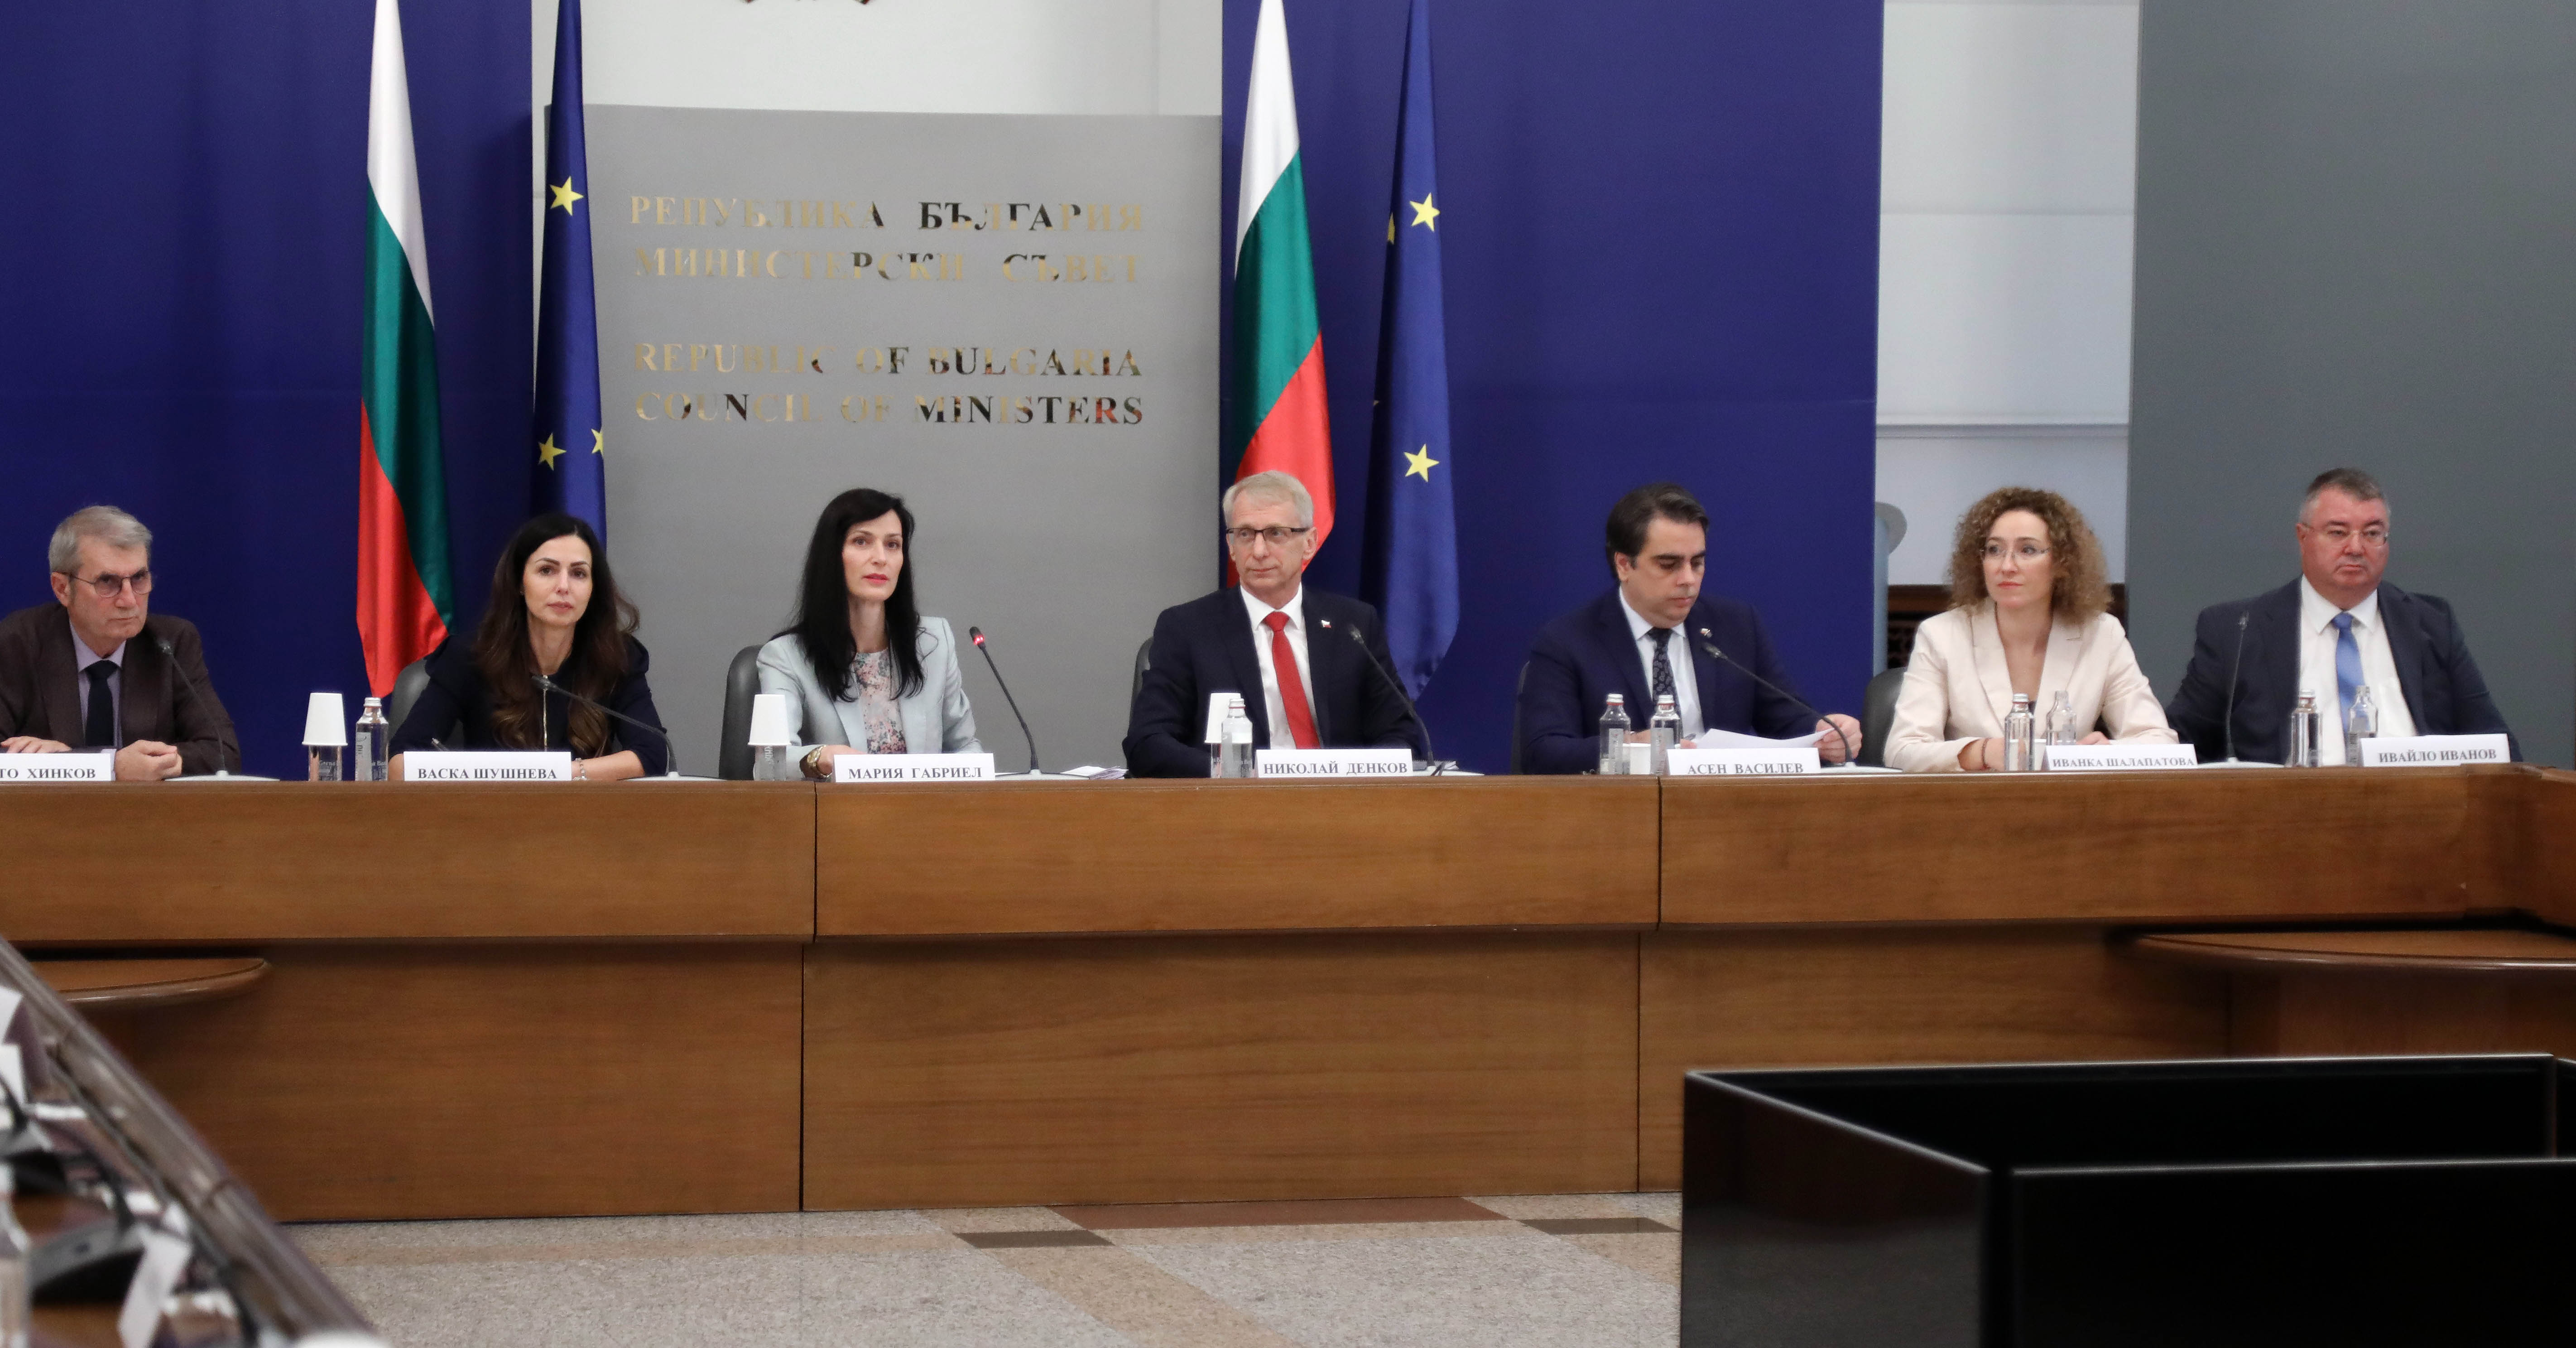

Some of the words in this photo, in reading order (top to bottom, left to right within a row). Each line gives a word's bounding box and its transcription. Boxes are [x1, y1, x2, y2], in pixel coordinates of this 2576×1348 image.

[630, 196, 885, 229] РЕПУБЛИКА
[918, 201, 1143, 231] БЪЛГАРИЯ
[636, 247, 964, 281] МИНИСТЕРСКИ
[1002, 253, 1143, 283] СЪВЕТ
[634, 343, 836, 374] REPUBLIC
[855, 347, 909, 374] OF
[928, 347, 1142, 376] BULGARIA
[636, 391, 823, 423] COUNCIL
[841, 394, 895, 423] OF
[911, 395, 1143, 424] MINISTERS
[2052, 759, 2103, 767] ИВАНКА
[2106, 758, 2194, 766] ШАЛАПАТОВА
[2379, 749, 2437, 763] ИВАЙЛО
[2440, 748, 2497, 761] ИВАНОВ
[27, 768, 96, 778] ХИНКОВ
[418, 768, 469, 779] ВАСКА
[474, 768, 557, 779] ШУШНЕВА
[848, 768, 904, 779] МАРИЯ
[912, 767, 982, 778] ГАБРИЕЛ
[1264, 761, 1339, 774] НИКОЛАЙ
[1346, 763, 1408, 775] ДЕНКОВ
[1687, 764, 1727, 774] АСЕН
[1735, 763, 1804, 774] ВАСИЛЕВ
